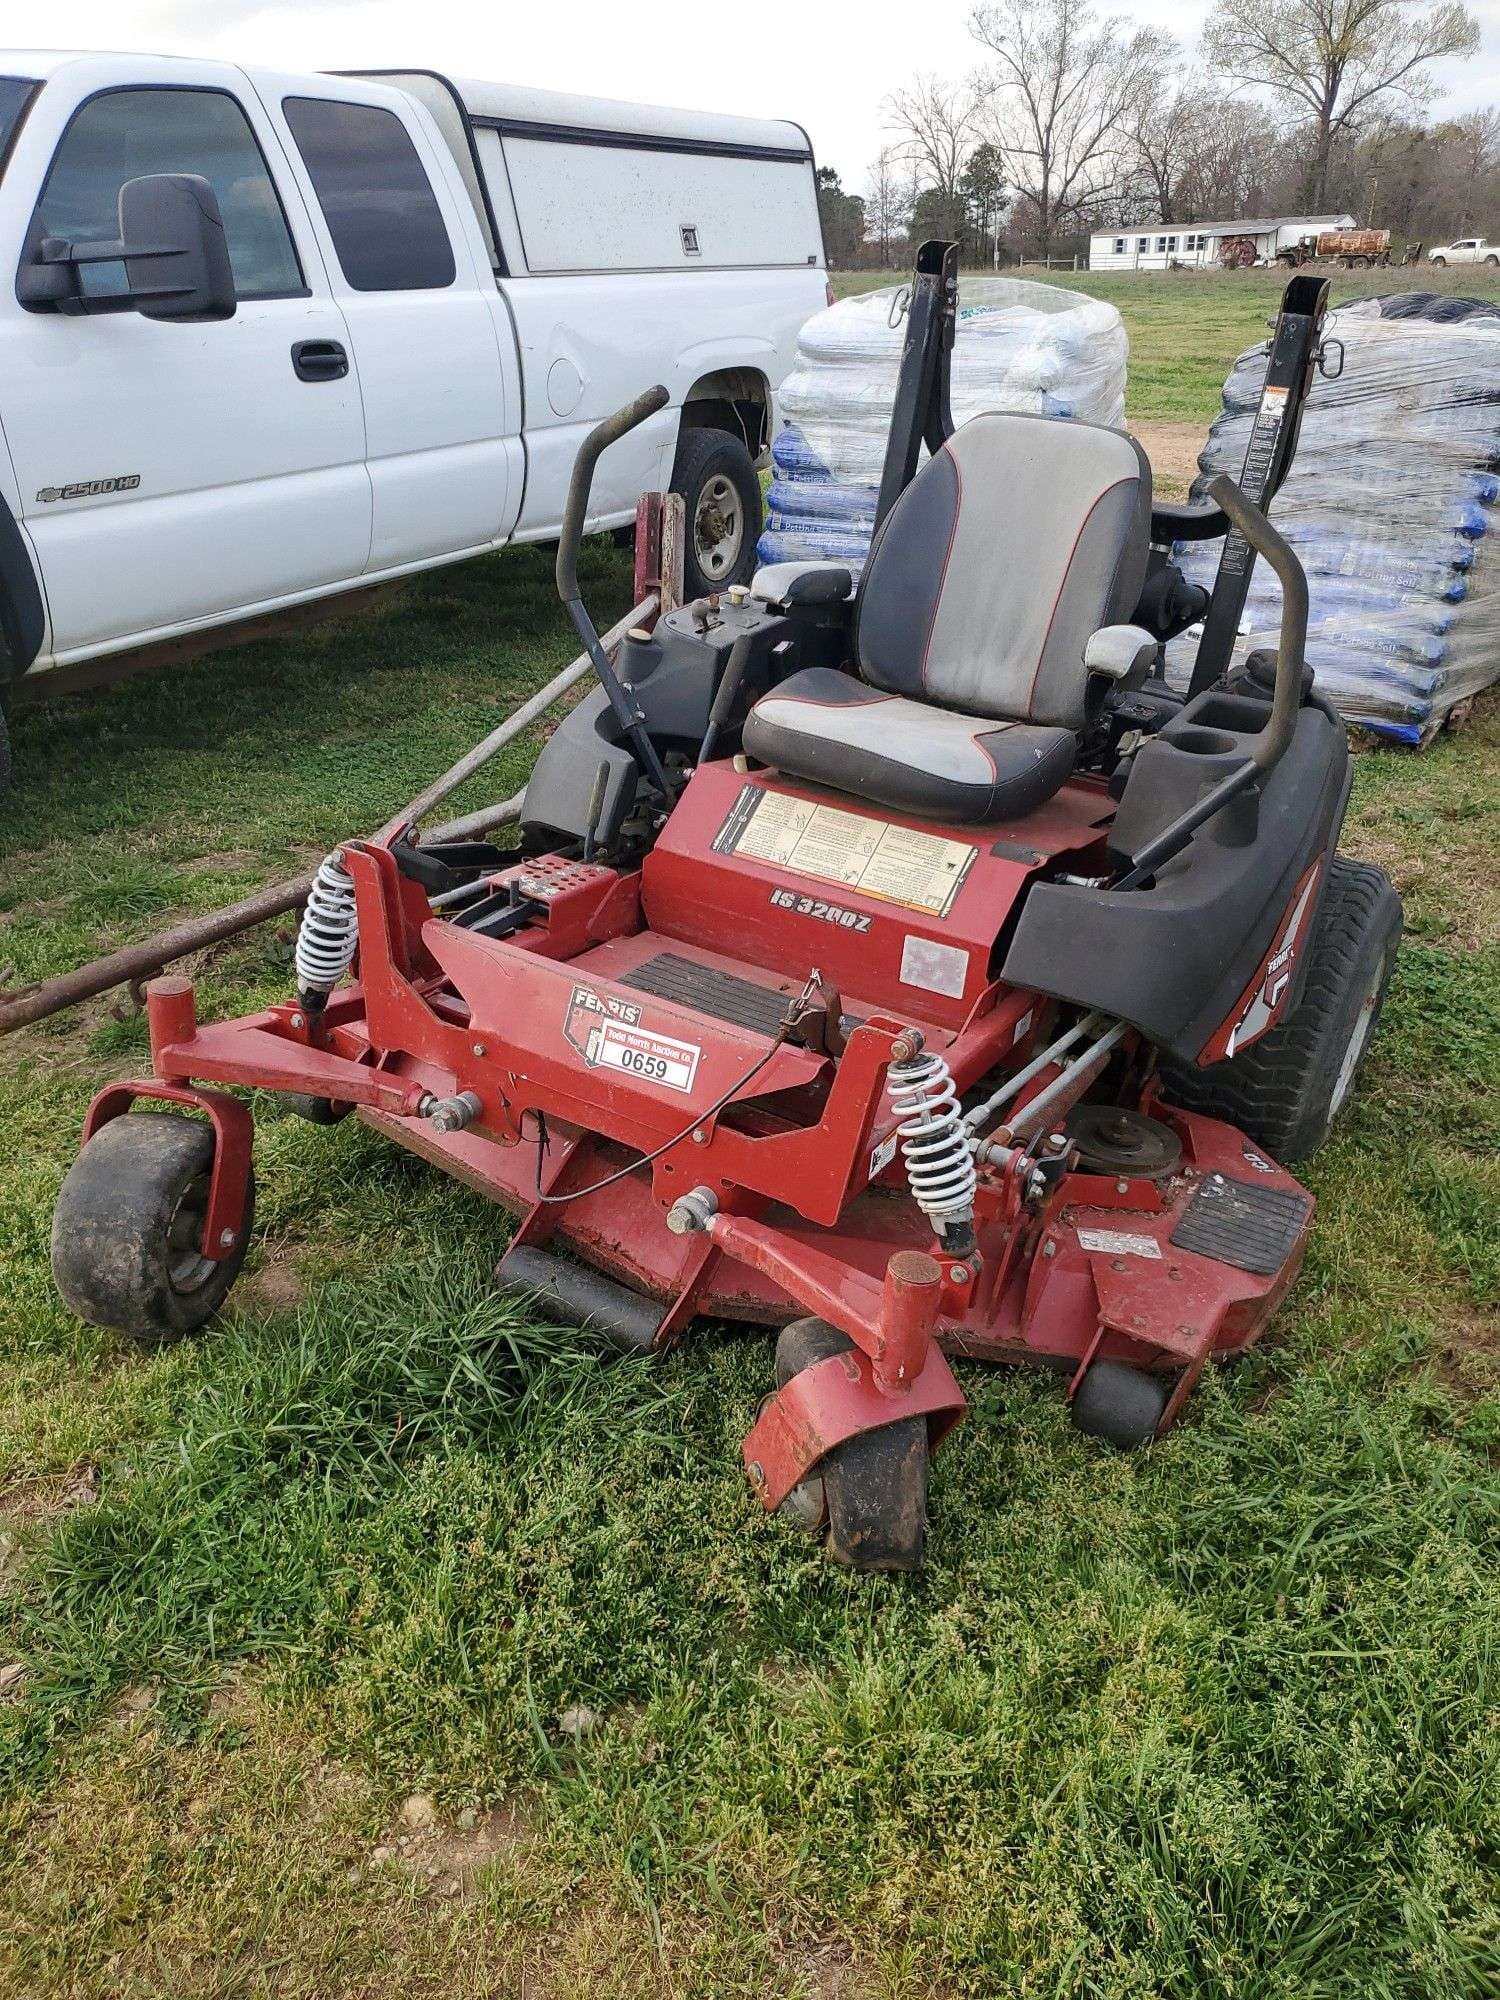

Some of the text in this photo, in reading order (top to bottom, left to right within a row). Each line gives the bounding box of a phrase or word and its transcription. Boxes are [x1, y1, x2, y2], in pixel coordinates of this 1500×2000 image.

[63, 475, 141, 499] 2500 HD
[769, 889, 795, 911] IS
[621, 1049, 668, 1079] 0659
